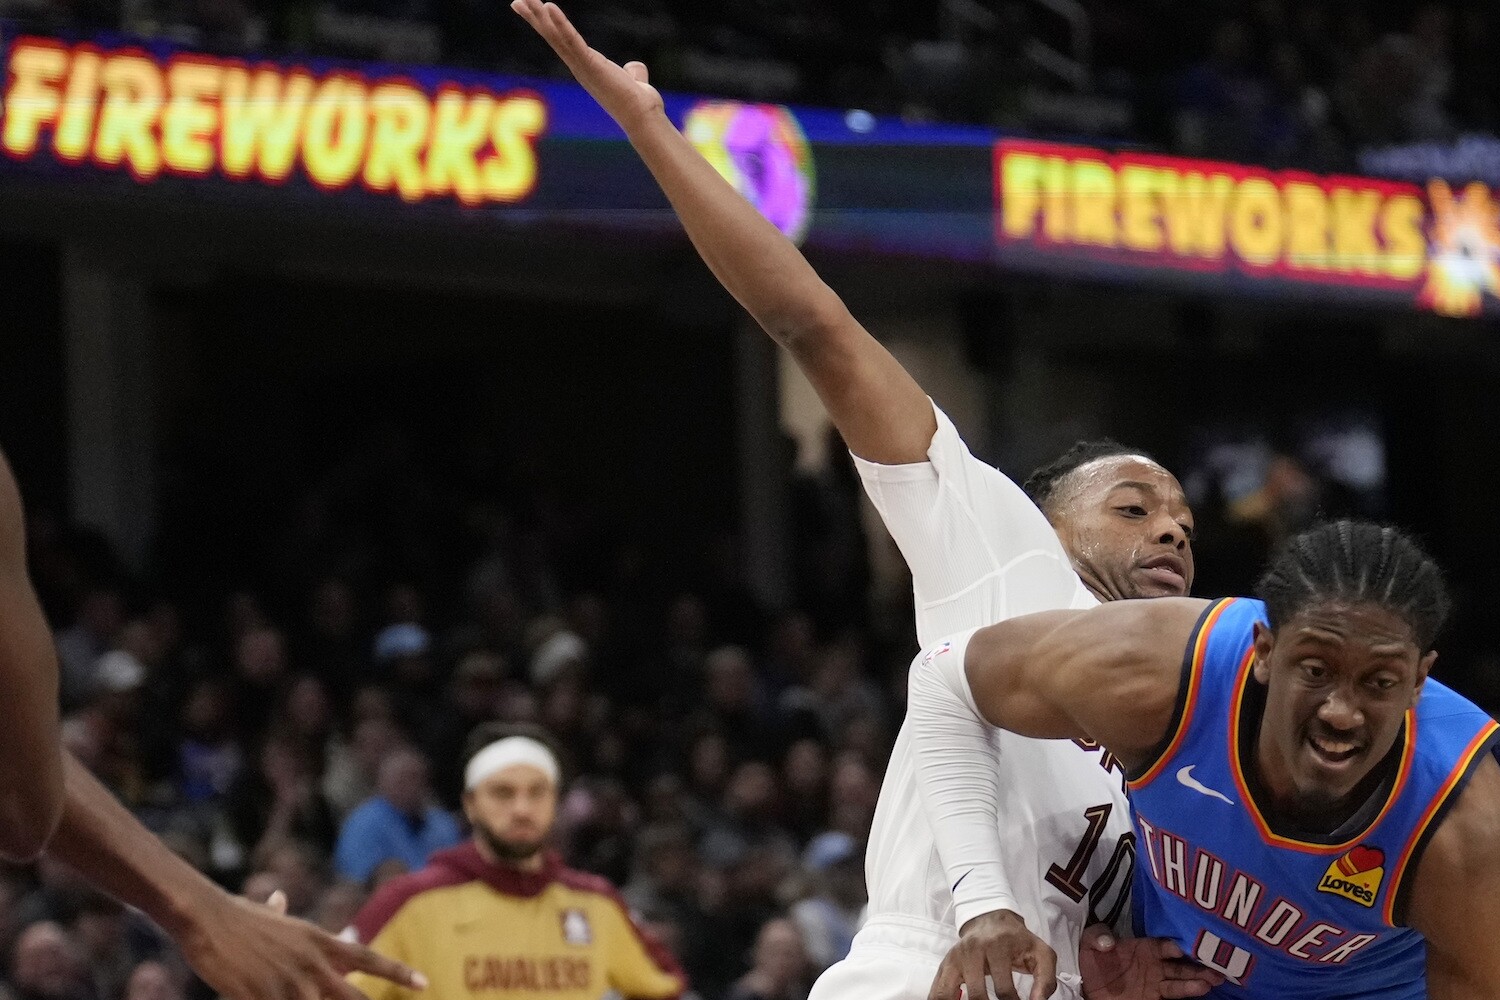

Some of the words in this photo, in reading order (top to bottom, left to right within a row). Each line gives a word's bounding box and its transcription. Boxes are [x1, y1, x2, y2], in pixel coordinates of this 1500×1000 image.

[3, 38, 547, 205] FIREWORKS
[1000, 148, 1426, 284] FIREWORKS
[1044, 803, 1137, 929] 10
[1136, 811, 1382, 966] THUNDER
[464, 954, 593, 991] CAVALIERS
